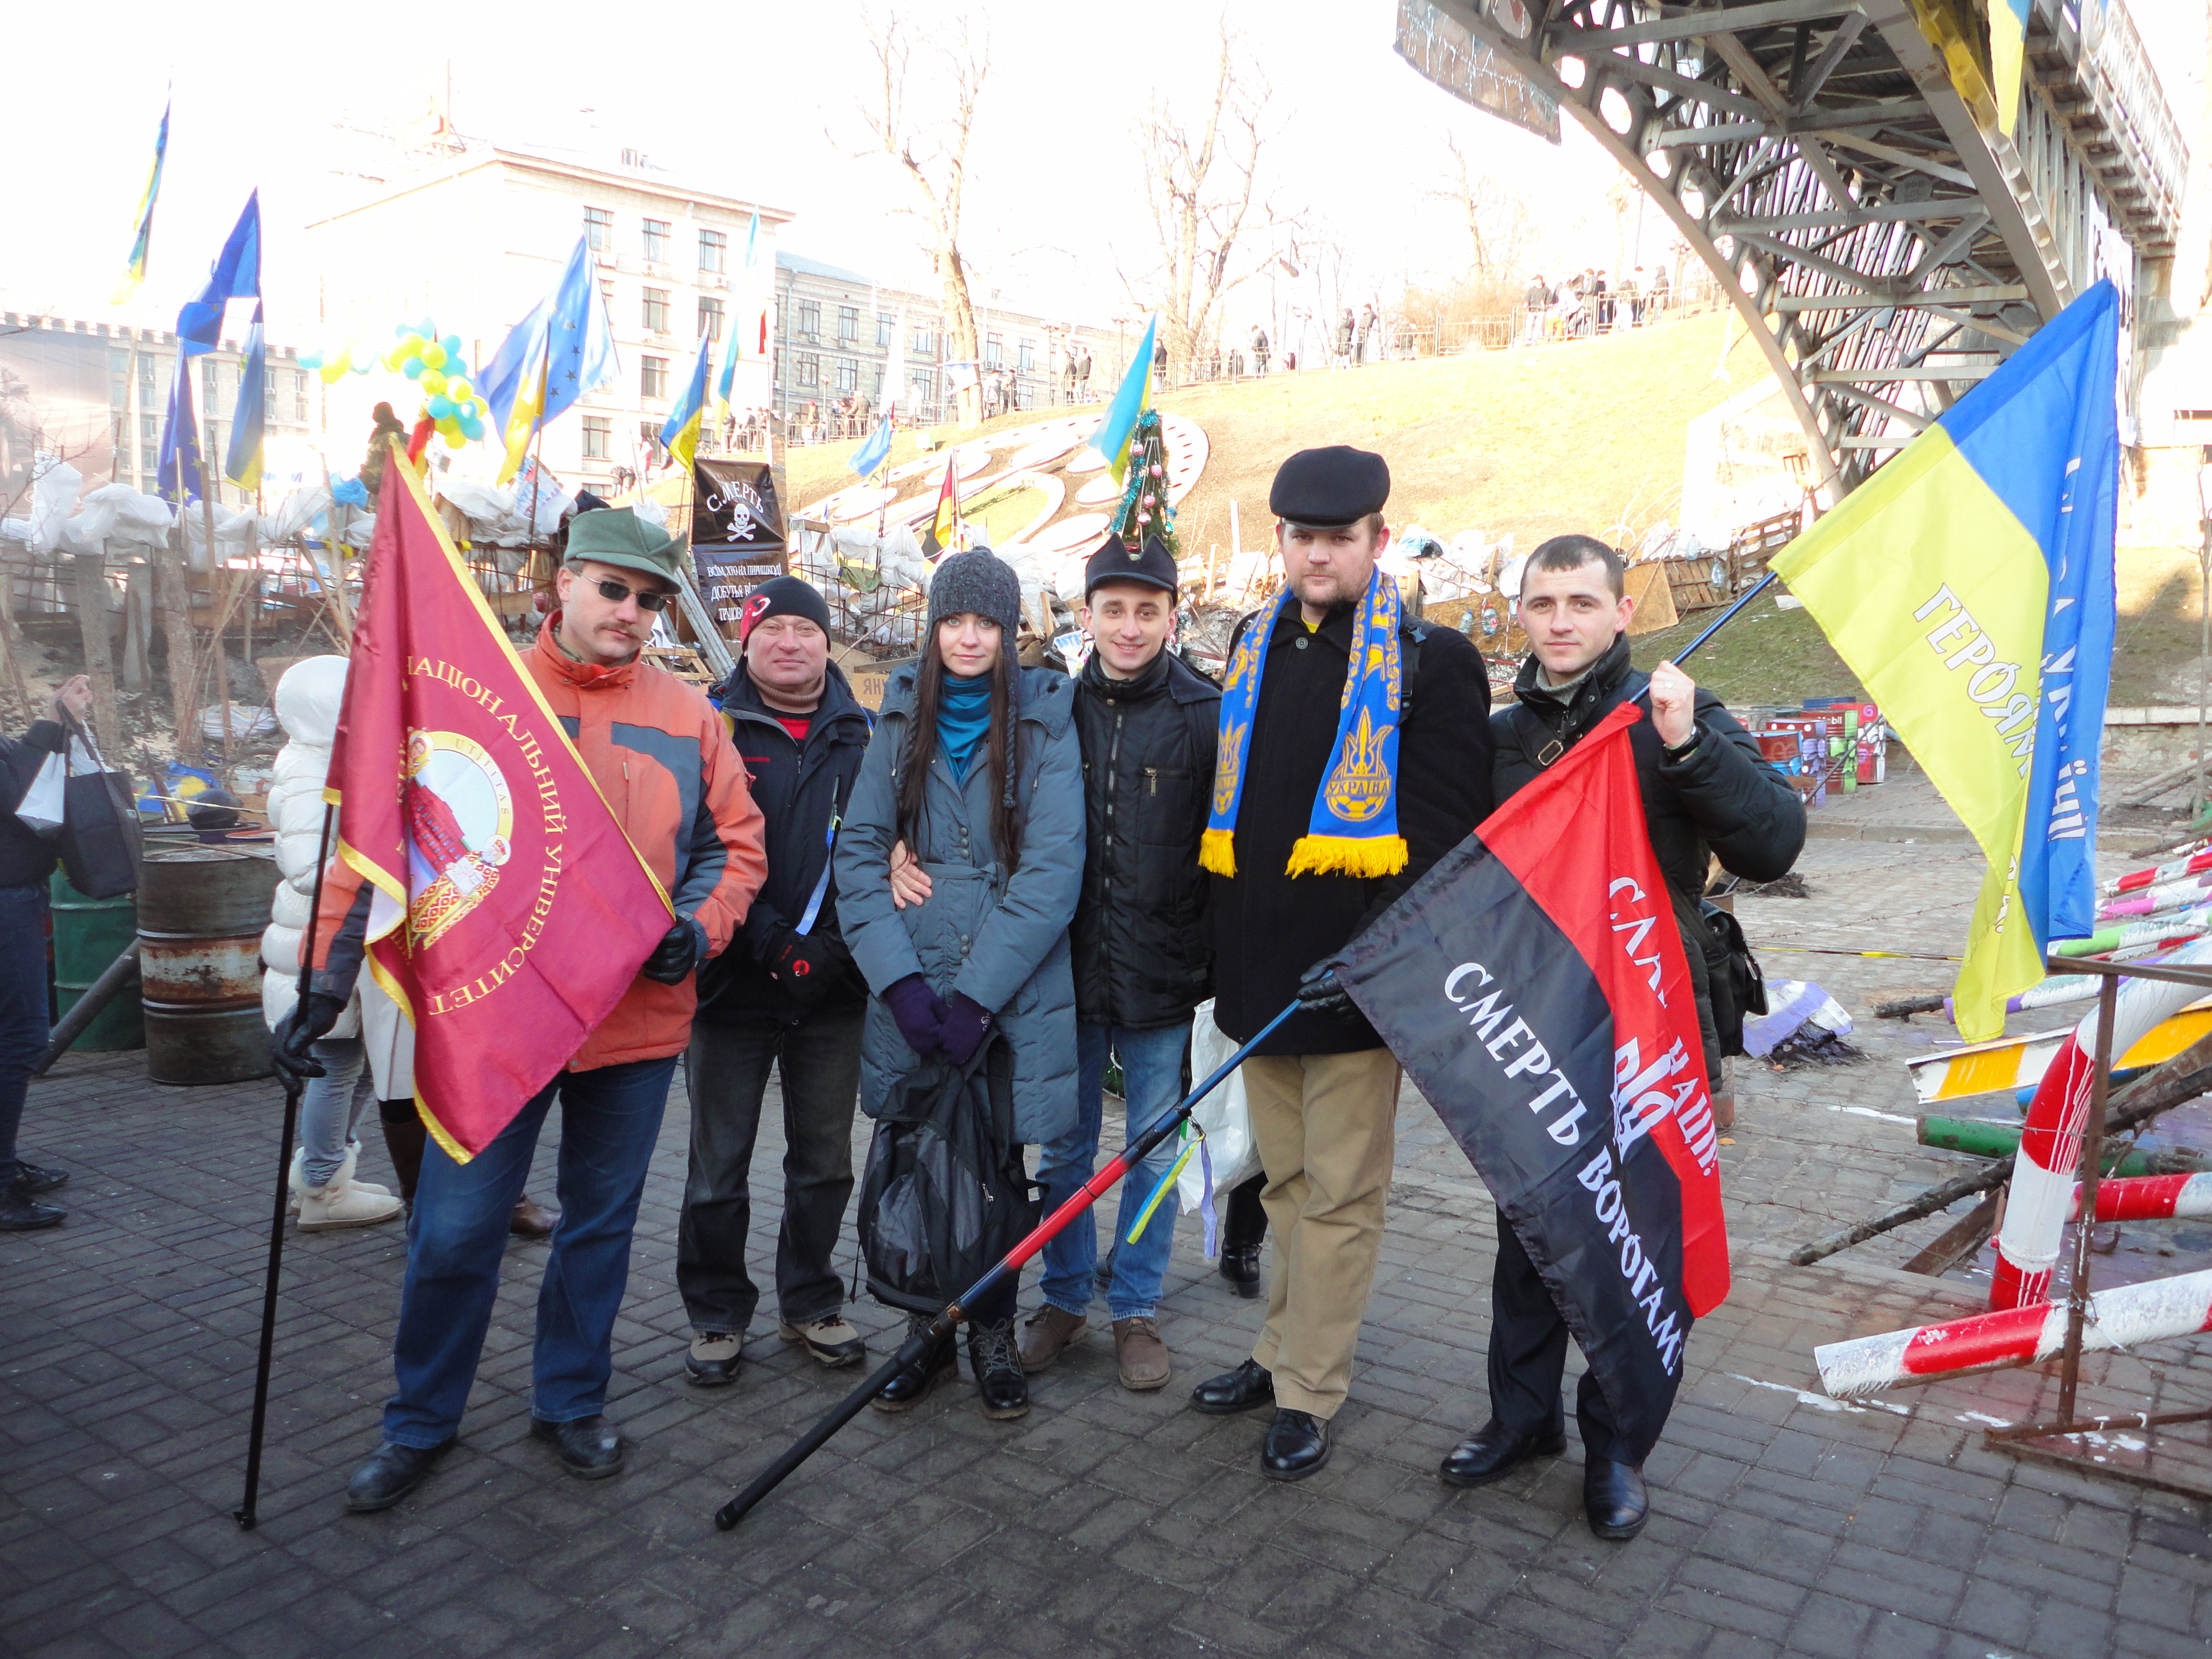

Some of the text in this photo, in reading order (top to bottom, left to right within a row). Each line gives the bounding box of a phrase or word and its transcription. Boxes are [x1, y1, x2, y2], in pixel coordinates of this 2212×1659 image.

[707, 481, 764, 514] СМЕРТЬ
[726, 565, 738, 576] ХТО
[738, 565, 746, 576] НА
[455, 738, 510, 815] UTILITAS
[1328, 779, 1389, 795] УКРАЇНА
[429, 845, 563, 1016] УНІВЕРСИТЕТ
[1444, 962, 1683, 1376] СМЕРТЬ ВОРОГАМ!
